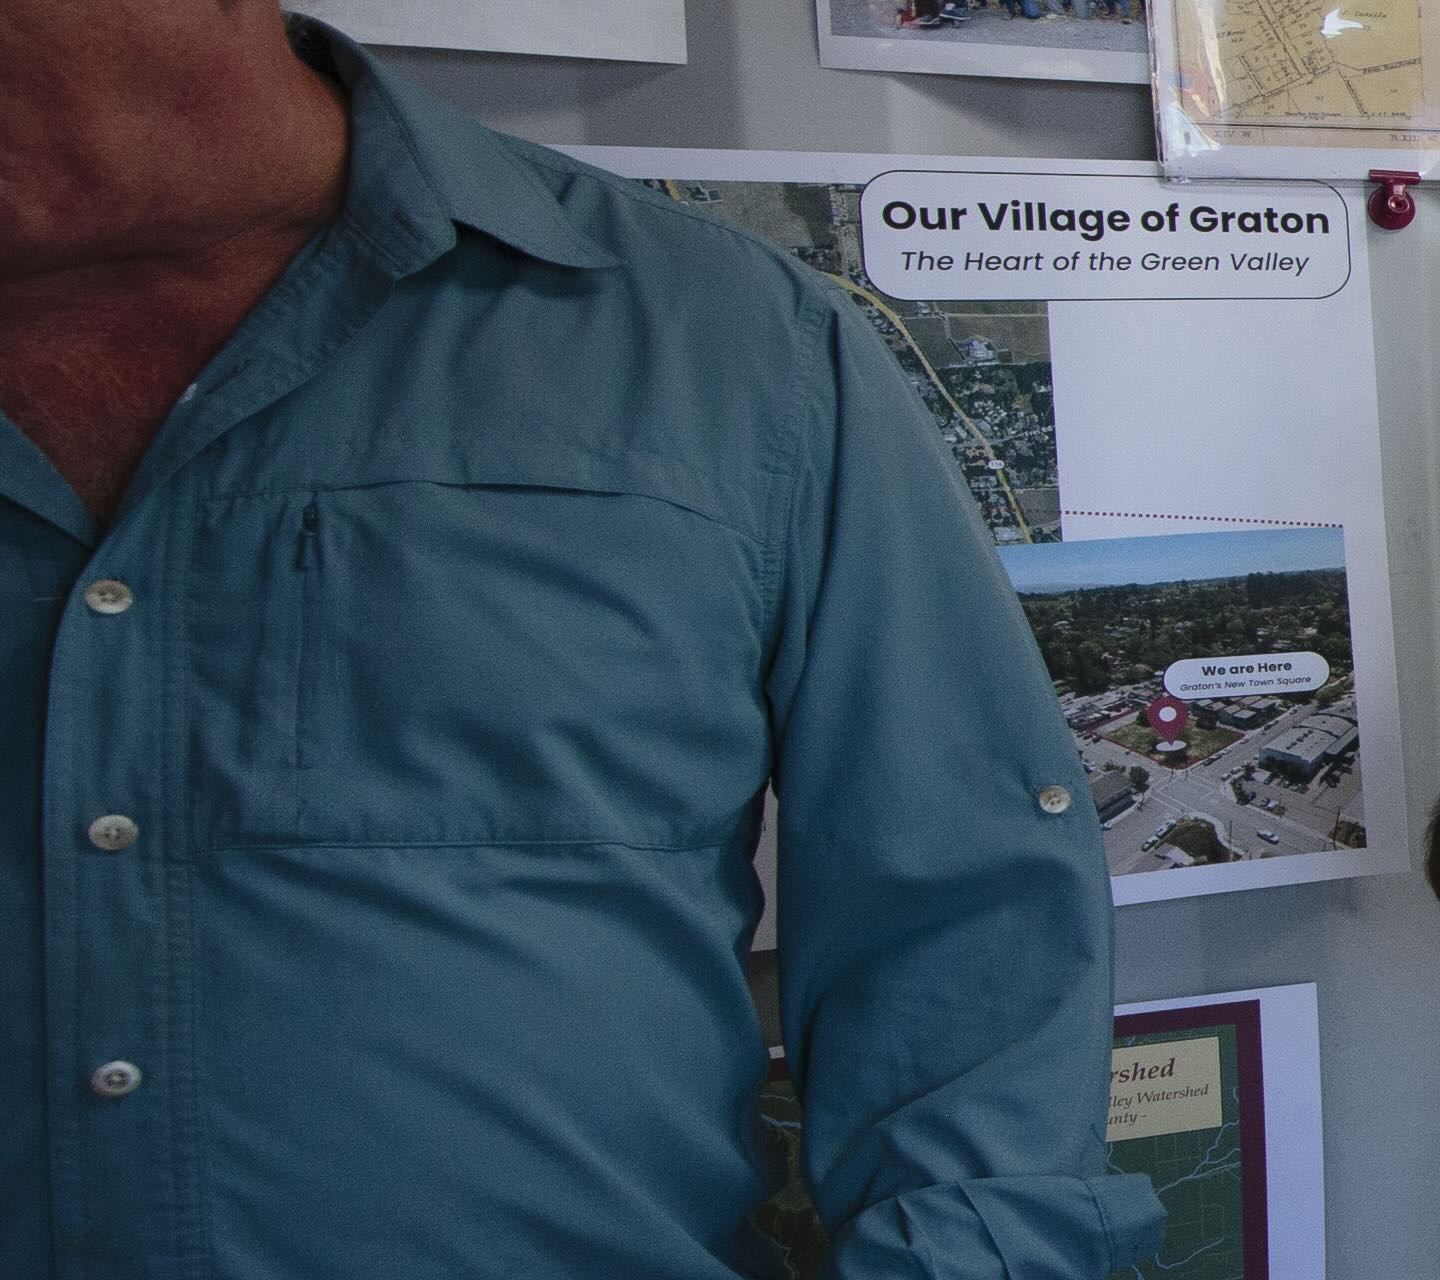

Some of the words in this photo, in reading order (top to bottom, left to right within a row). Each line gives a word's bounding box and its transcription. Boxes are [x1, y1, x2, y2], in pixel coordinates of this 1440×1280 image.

[882, 201, 967, 230] Our
[977, 200, 1131, 241] Village
[1140, 202, 1180, 232] of
[1190, 205, 1330, 234] Graton
[901, 251, 954, 271] The
[964, 251, 1044, 272] Heart
[1052, 251, 1080, 271] of
[1089, 251, 1132, 272] the
[1140, 252, 1220, 272] Green
[1230, 252, 1310, 277] Valley
[1202, 665, 1226, 677] We
[1229, 664, 1254, 674] are
[1257, 662, 1292, 673] Here
[1180, 682, 1222, 692] Graton's
[1225, 681, 1246, 689] New
[1250, 679, 1274, 687] Town
[1277, 677, 1311, 686] Square
[1137, 1082, 1210, 1105] Watershed
